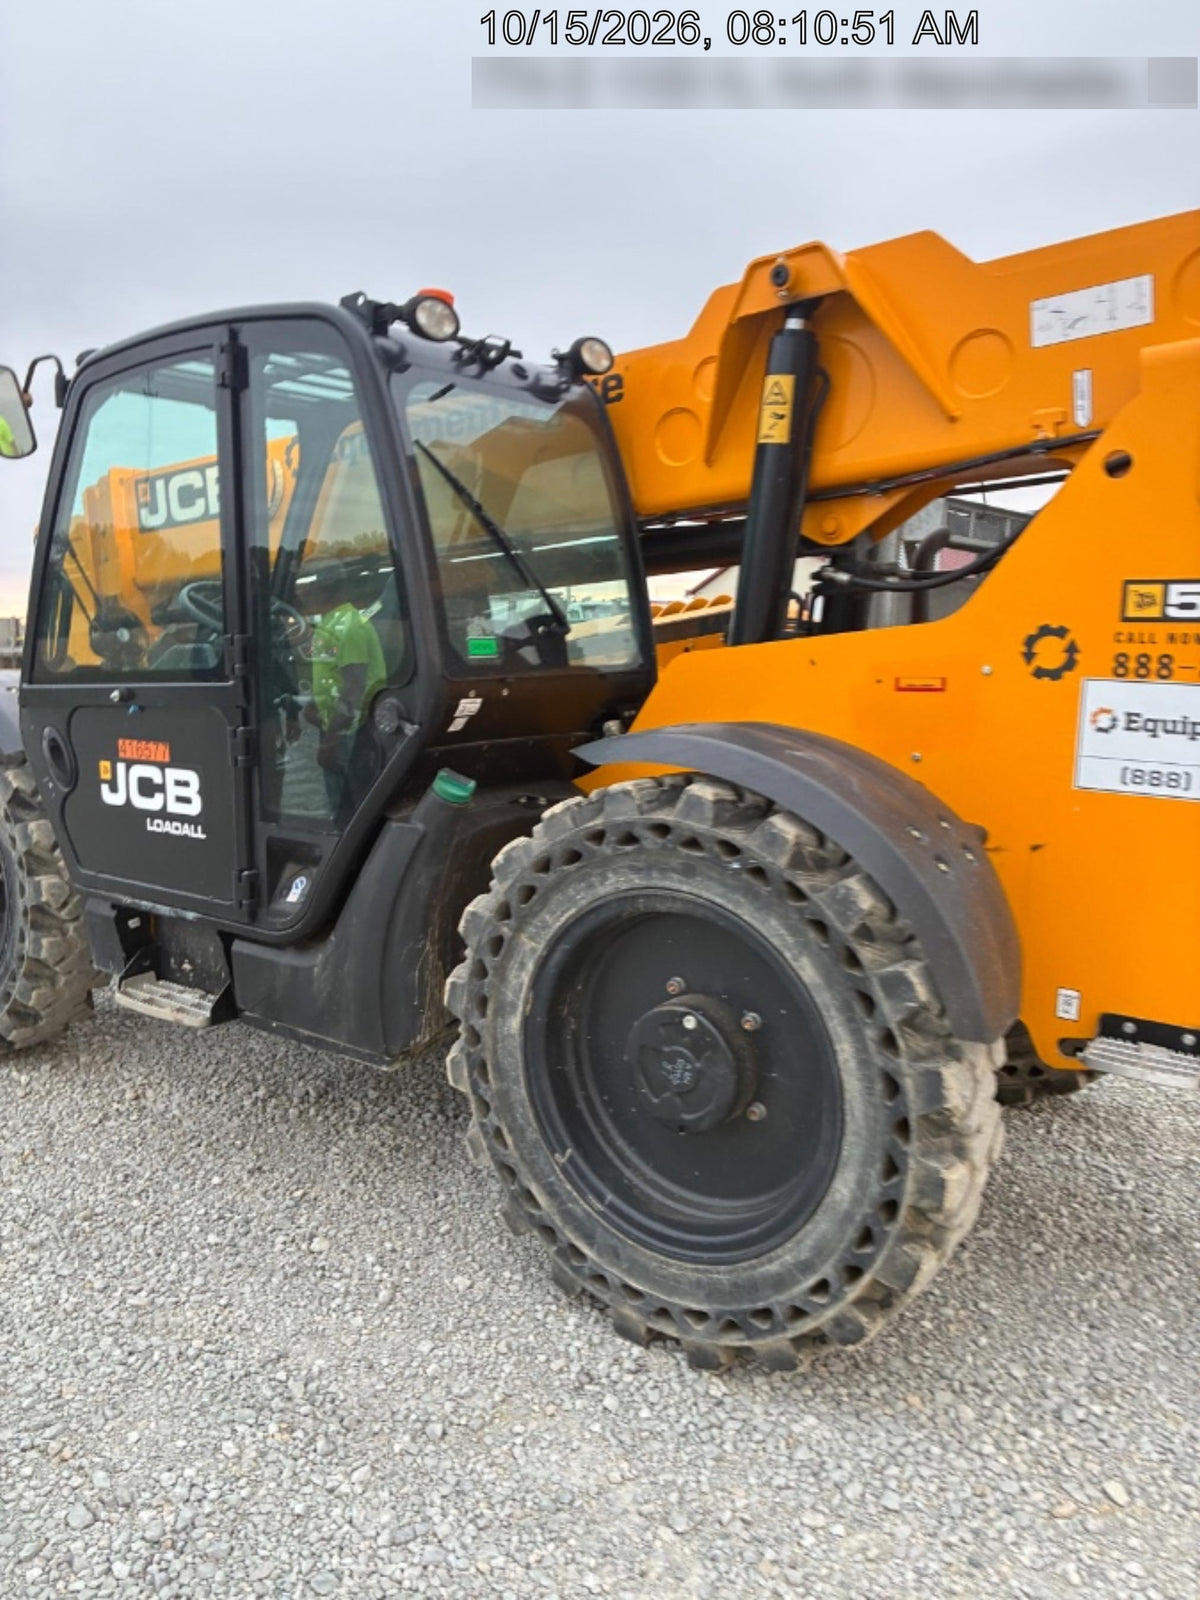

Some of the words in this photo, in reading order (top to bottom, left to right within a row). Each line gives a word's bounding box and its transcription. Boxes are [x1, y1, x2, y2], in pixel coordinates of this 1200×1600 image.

[1113, 631, 1158, 645] CALL
[1124, 711, 1200, 741] Equip
[100, 761, 202, 817] JCB
[1120, 766, 1192, 791] (888)
[146, 817, 207, 840] LOADALL
